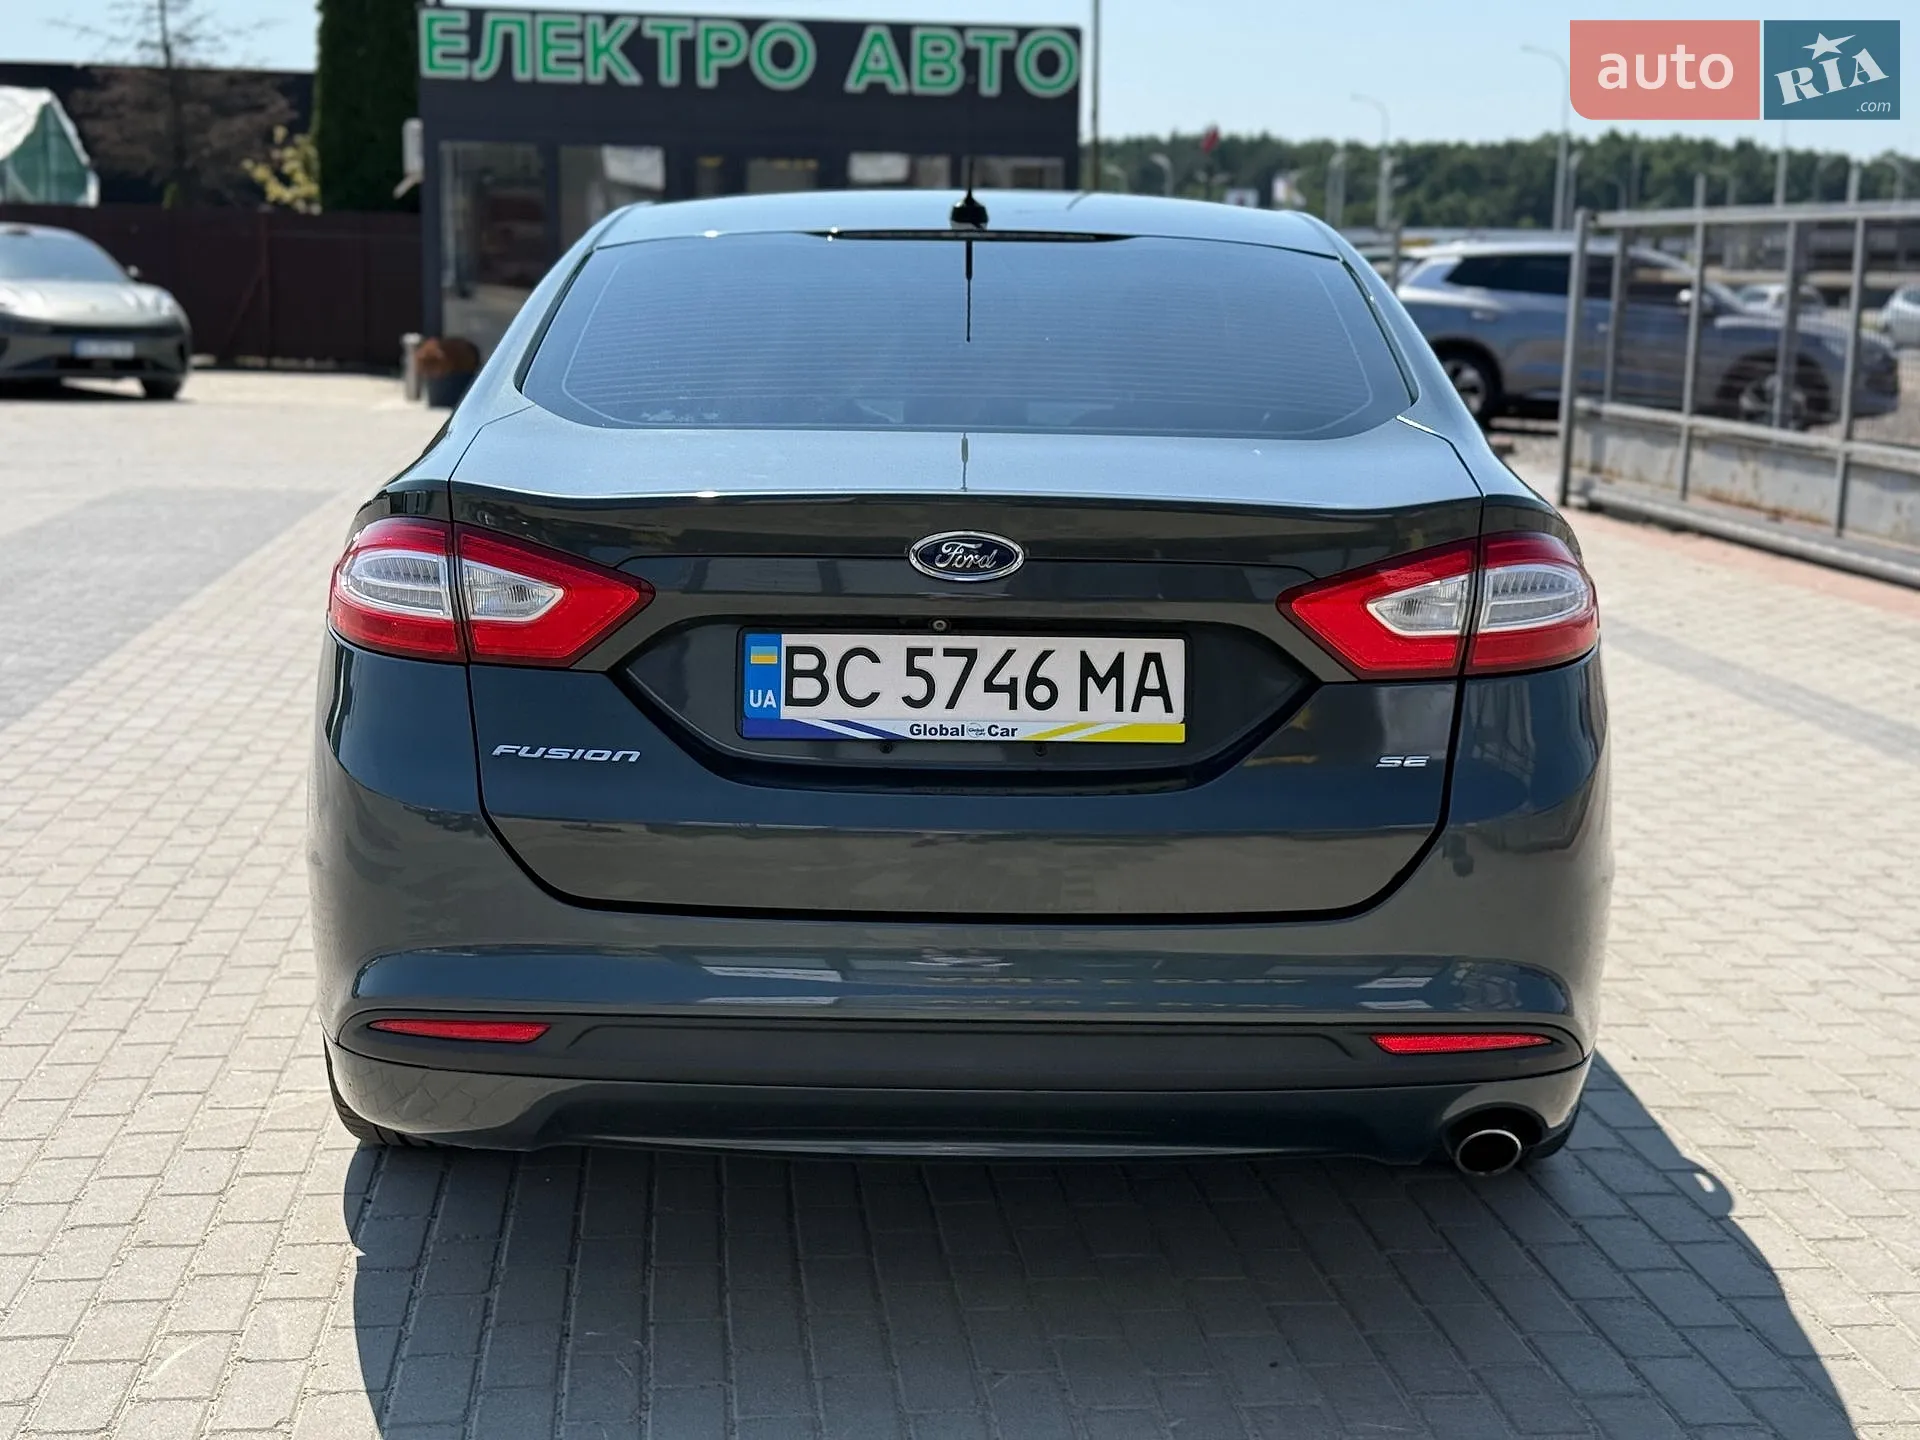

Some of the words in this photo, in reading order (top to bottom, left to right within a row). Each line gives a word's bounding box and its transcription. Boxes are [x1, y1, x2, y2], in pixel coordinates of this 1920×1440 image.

[420, 9, 816, 90] ЕЛЕКТРО
[844, 25, 1082, 98] АВТО
[934, 541, 999, 569] Ford
[784, 645, 881, 708] BC
[901, 647, 1058, 711] 5746
[1078, 650, 1174, 714] MA
[749, 689, 777, 709] UA
[909, 723, 966, 738] Global
[987, 724, 1018, 738] Car
[491, 744, 641, 763] FUSION
[1375, 755, 1430, 768] SE
